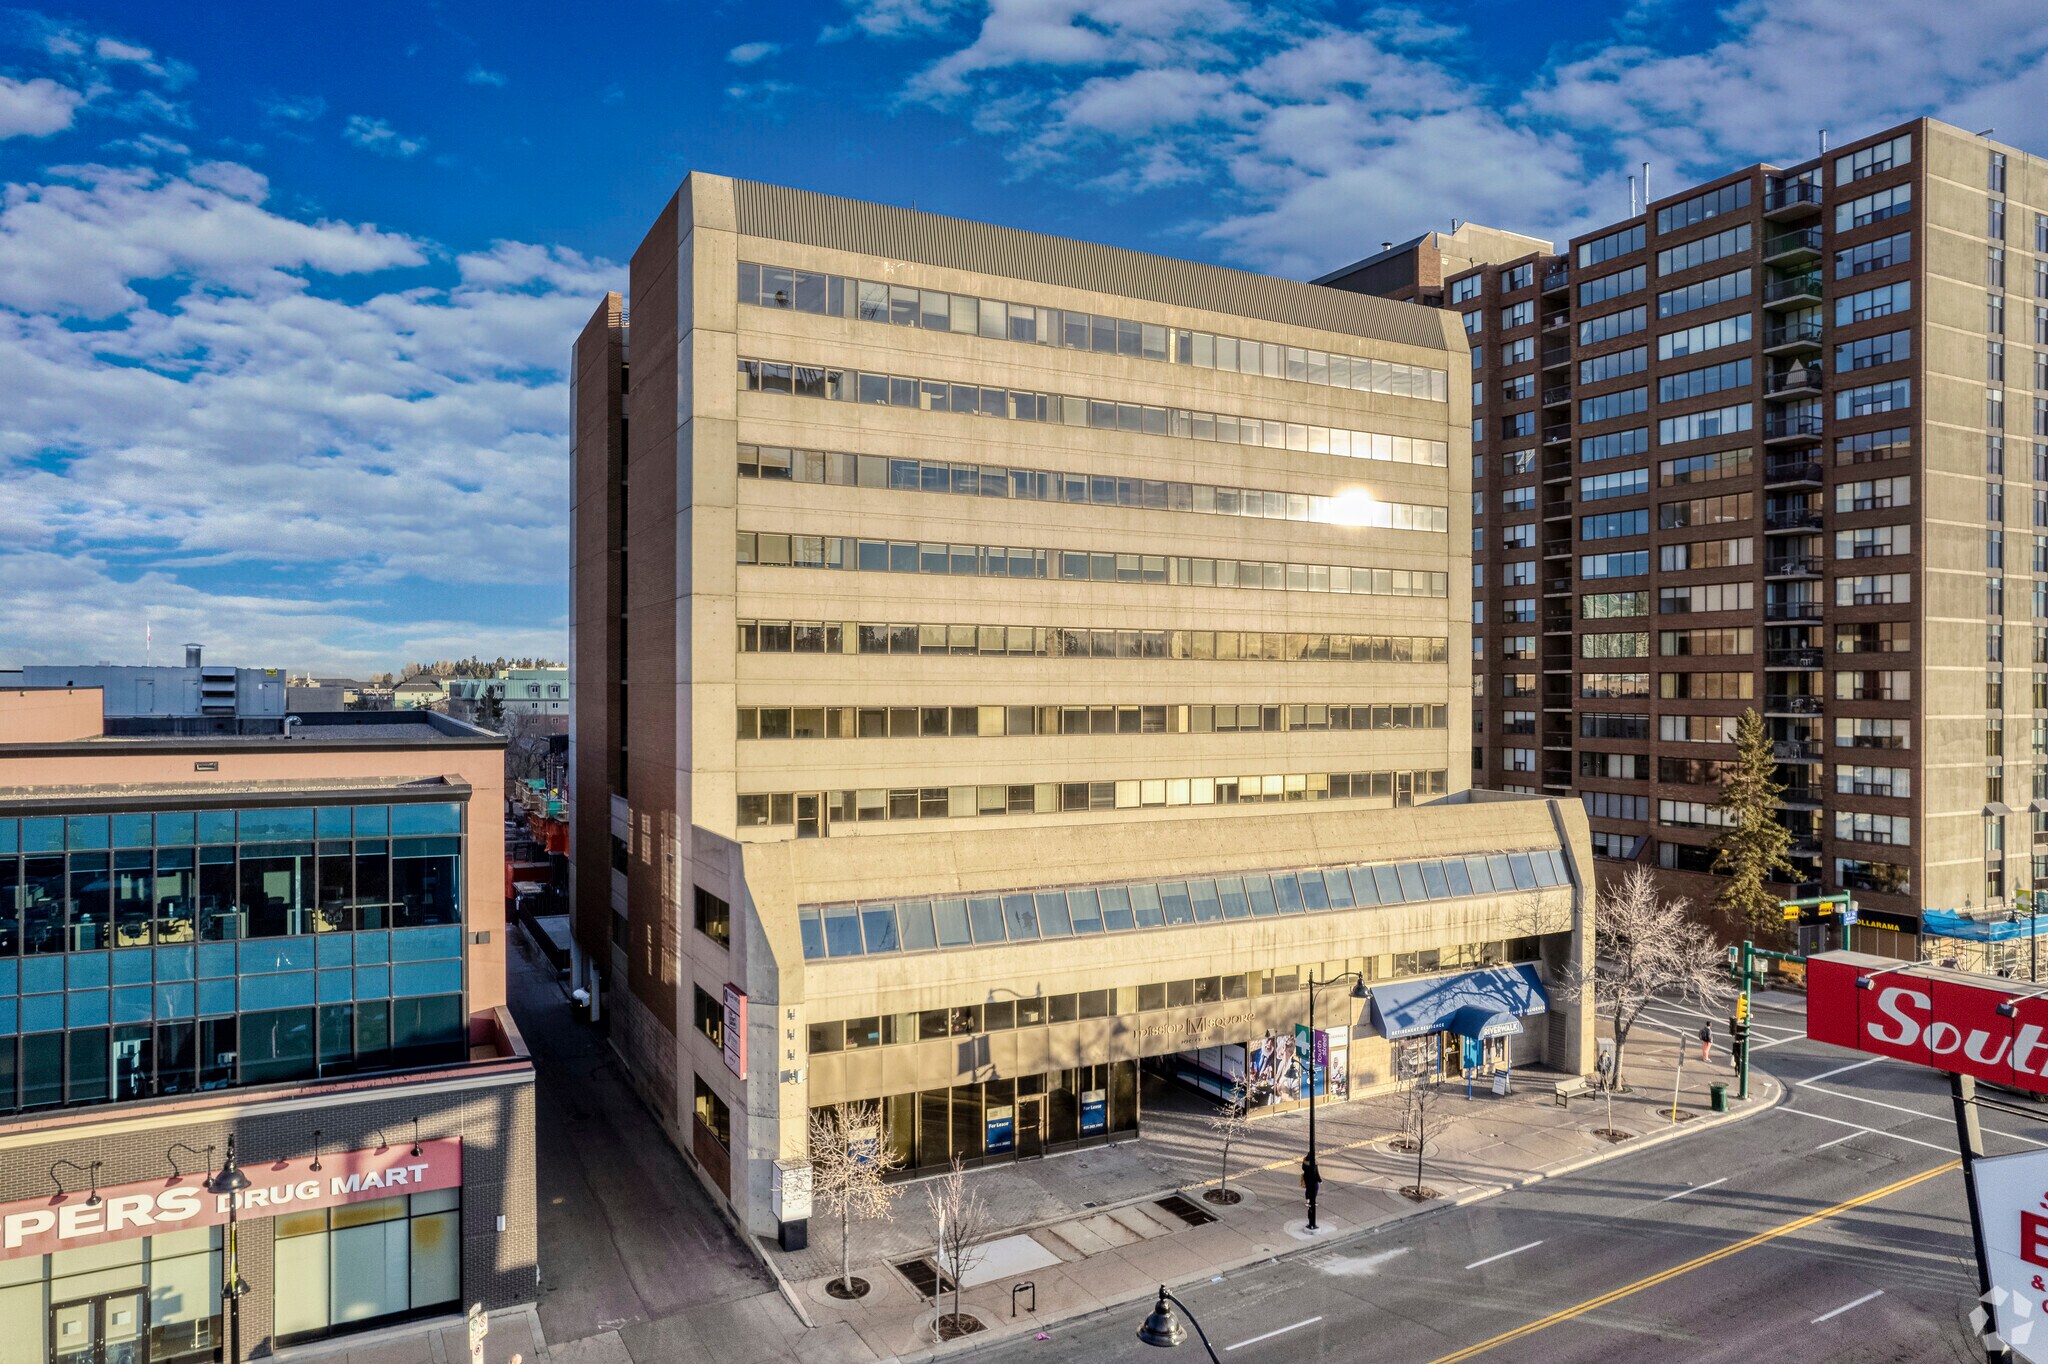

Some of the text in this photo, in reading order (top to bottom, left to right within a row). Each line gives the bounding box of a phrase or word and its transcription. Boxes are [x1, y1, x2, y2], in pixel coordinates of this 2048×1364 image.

[1856, 918, 1900, 932] OLLARAMA
[1391, 1021, 1445, 1036] RETIREMENT RESIDENCE
[1483, 1022, 1519, 1035] RIVERWALK
[0, 1163, 429, 1249] PERS DRUG MART
